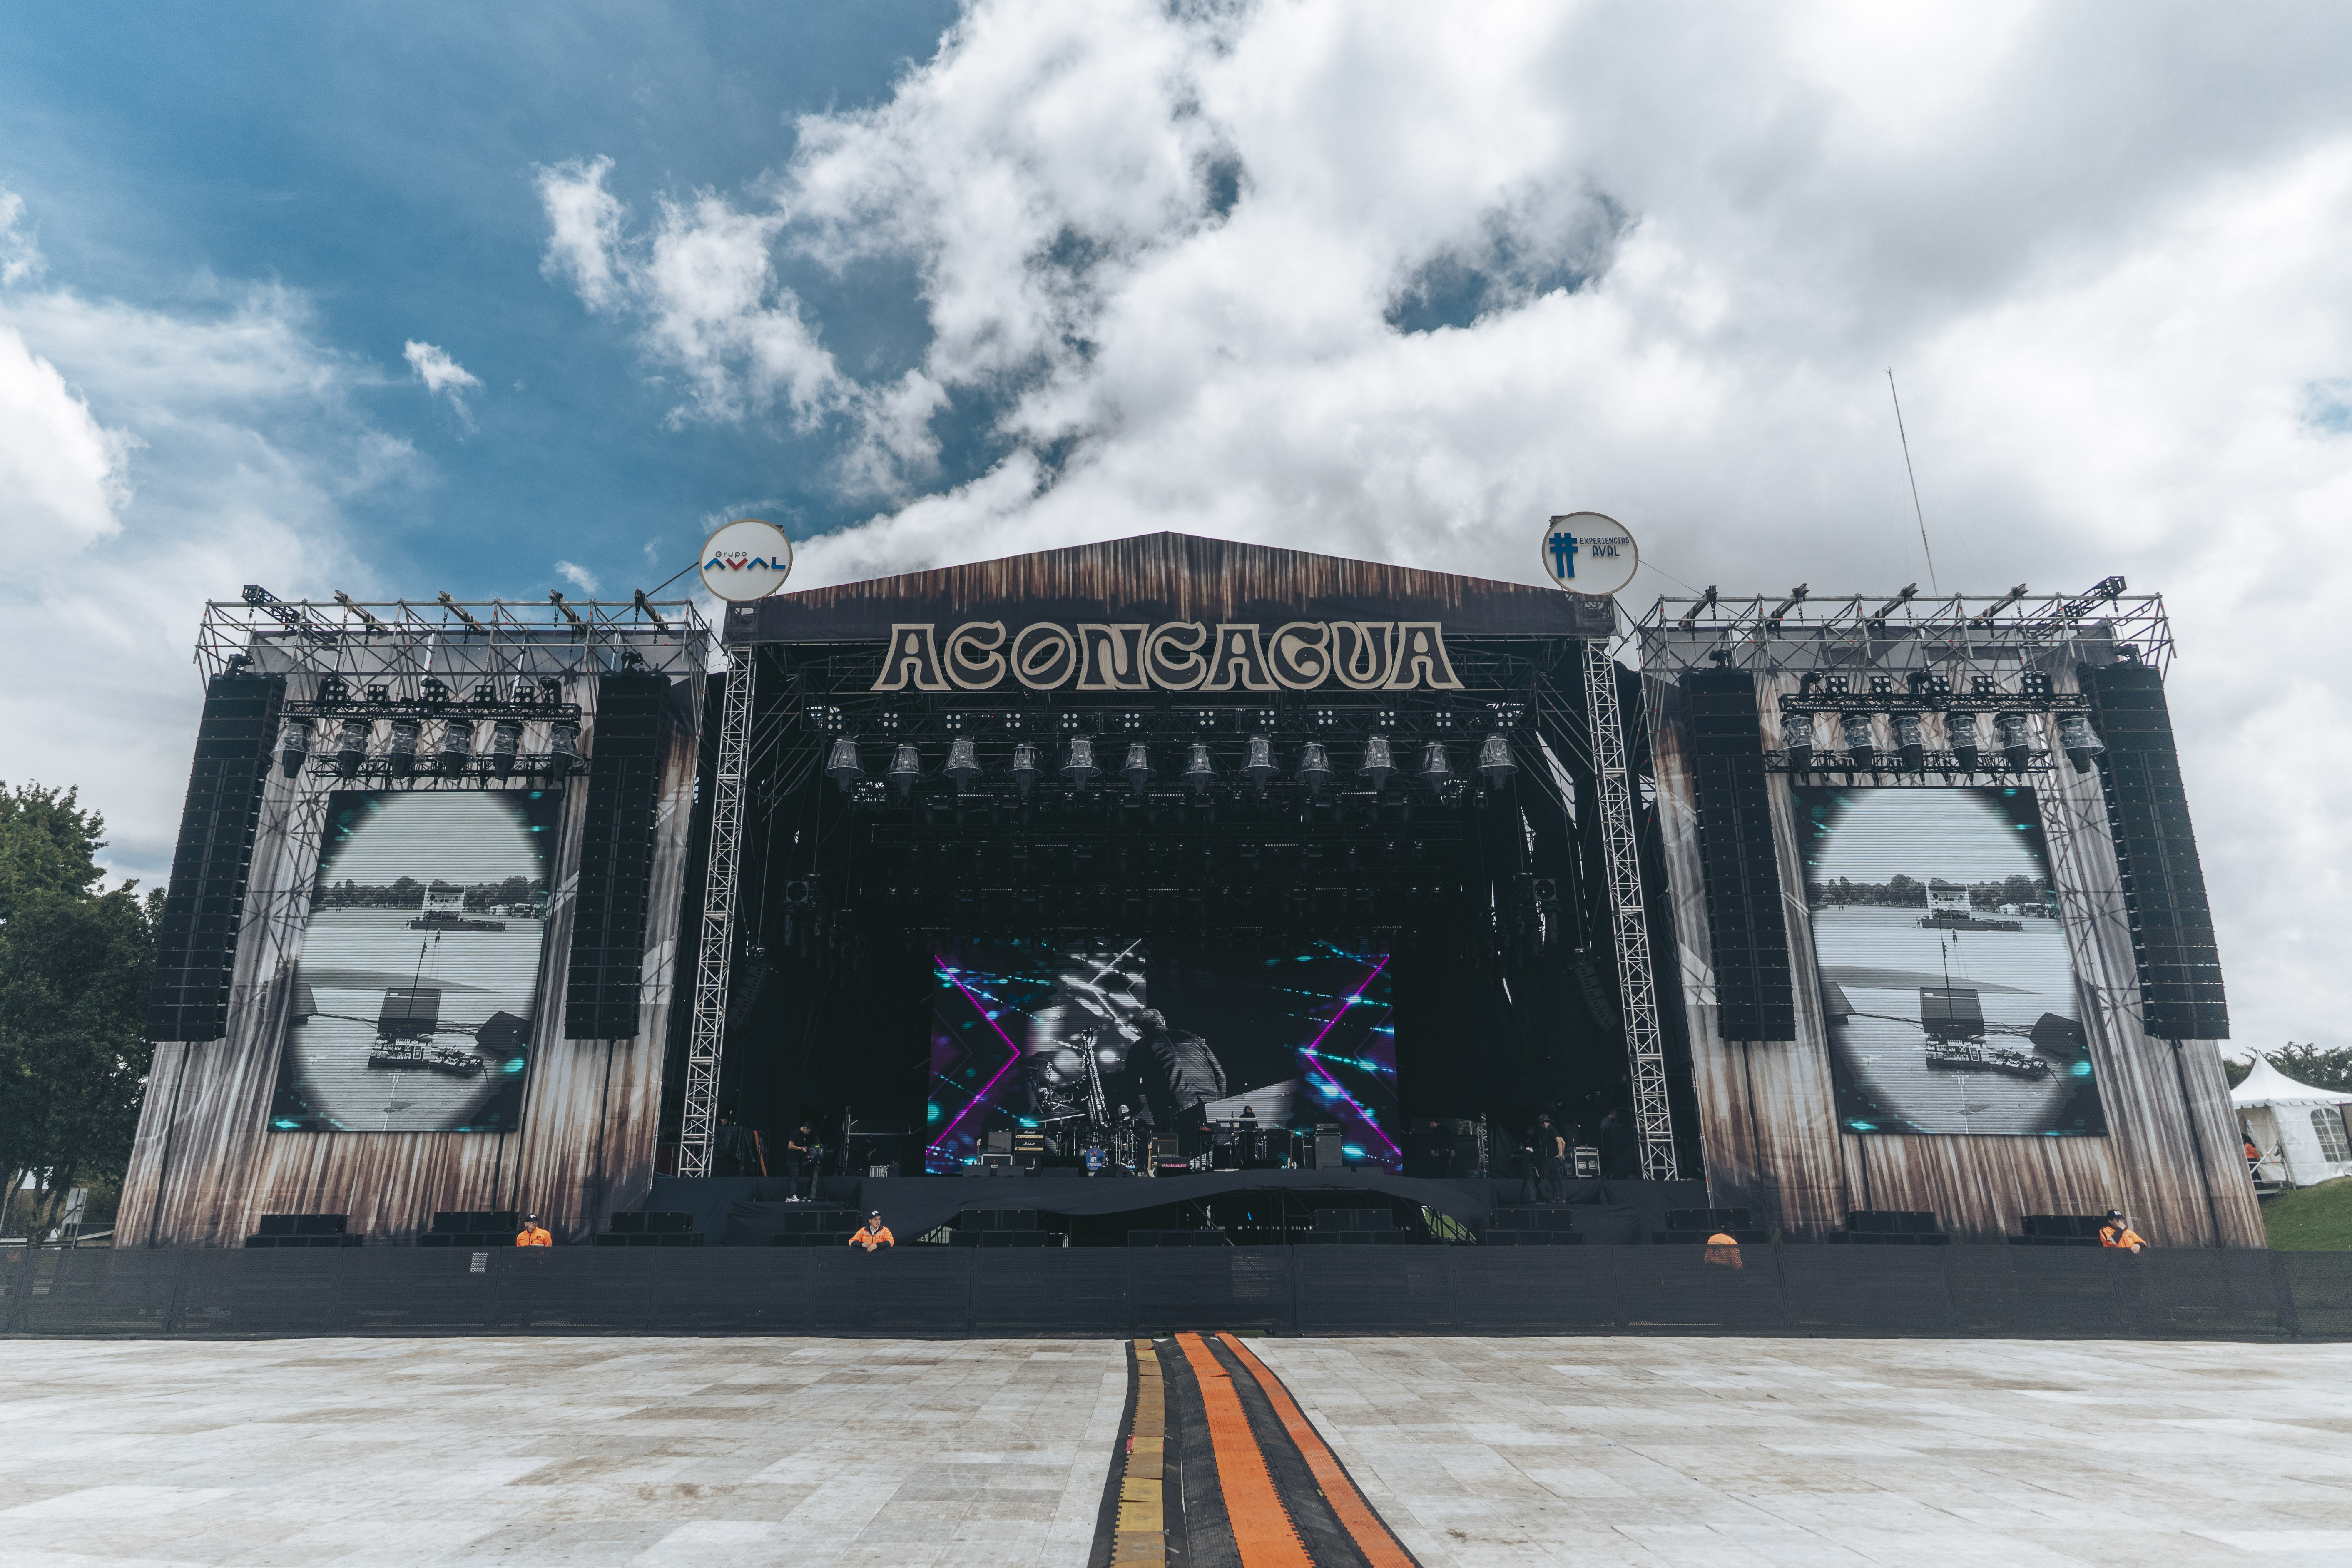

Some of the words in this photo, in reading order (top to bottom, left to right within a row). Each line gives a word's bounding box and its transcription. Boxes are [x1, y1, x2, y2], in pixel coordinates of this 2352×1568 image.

[1592, 545, 1620, 557] AVAL
[704, 557, 786, 570] AVAL
[870, 620, 1465, 690] ACONCAGUA
